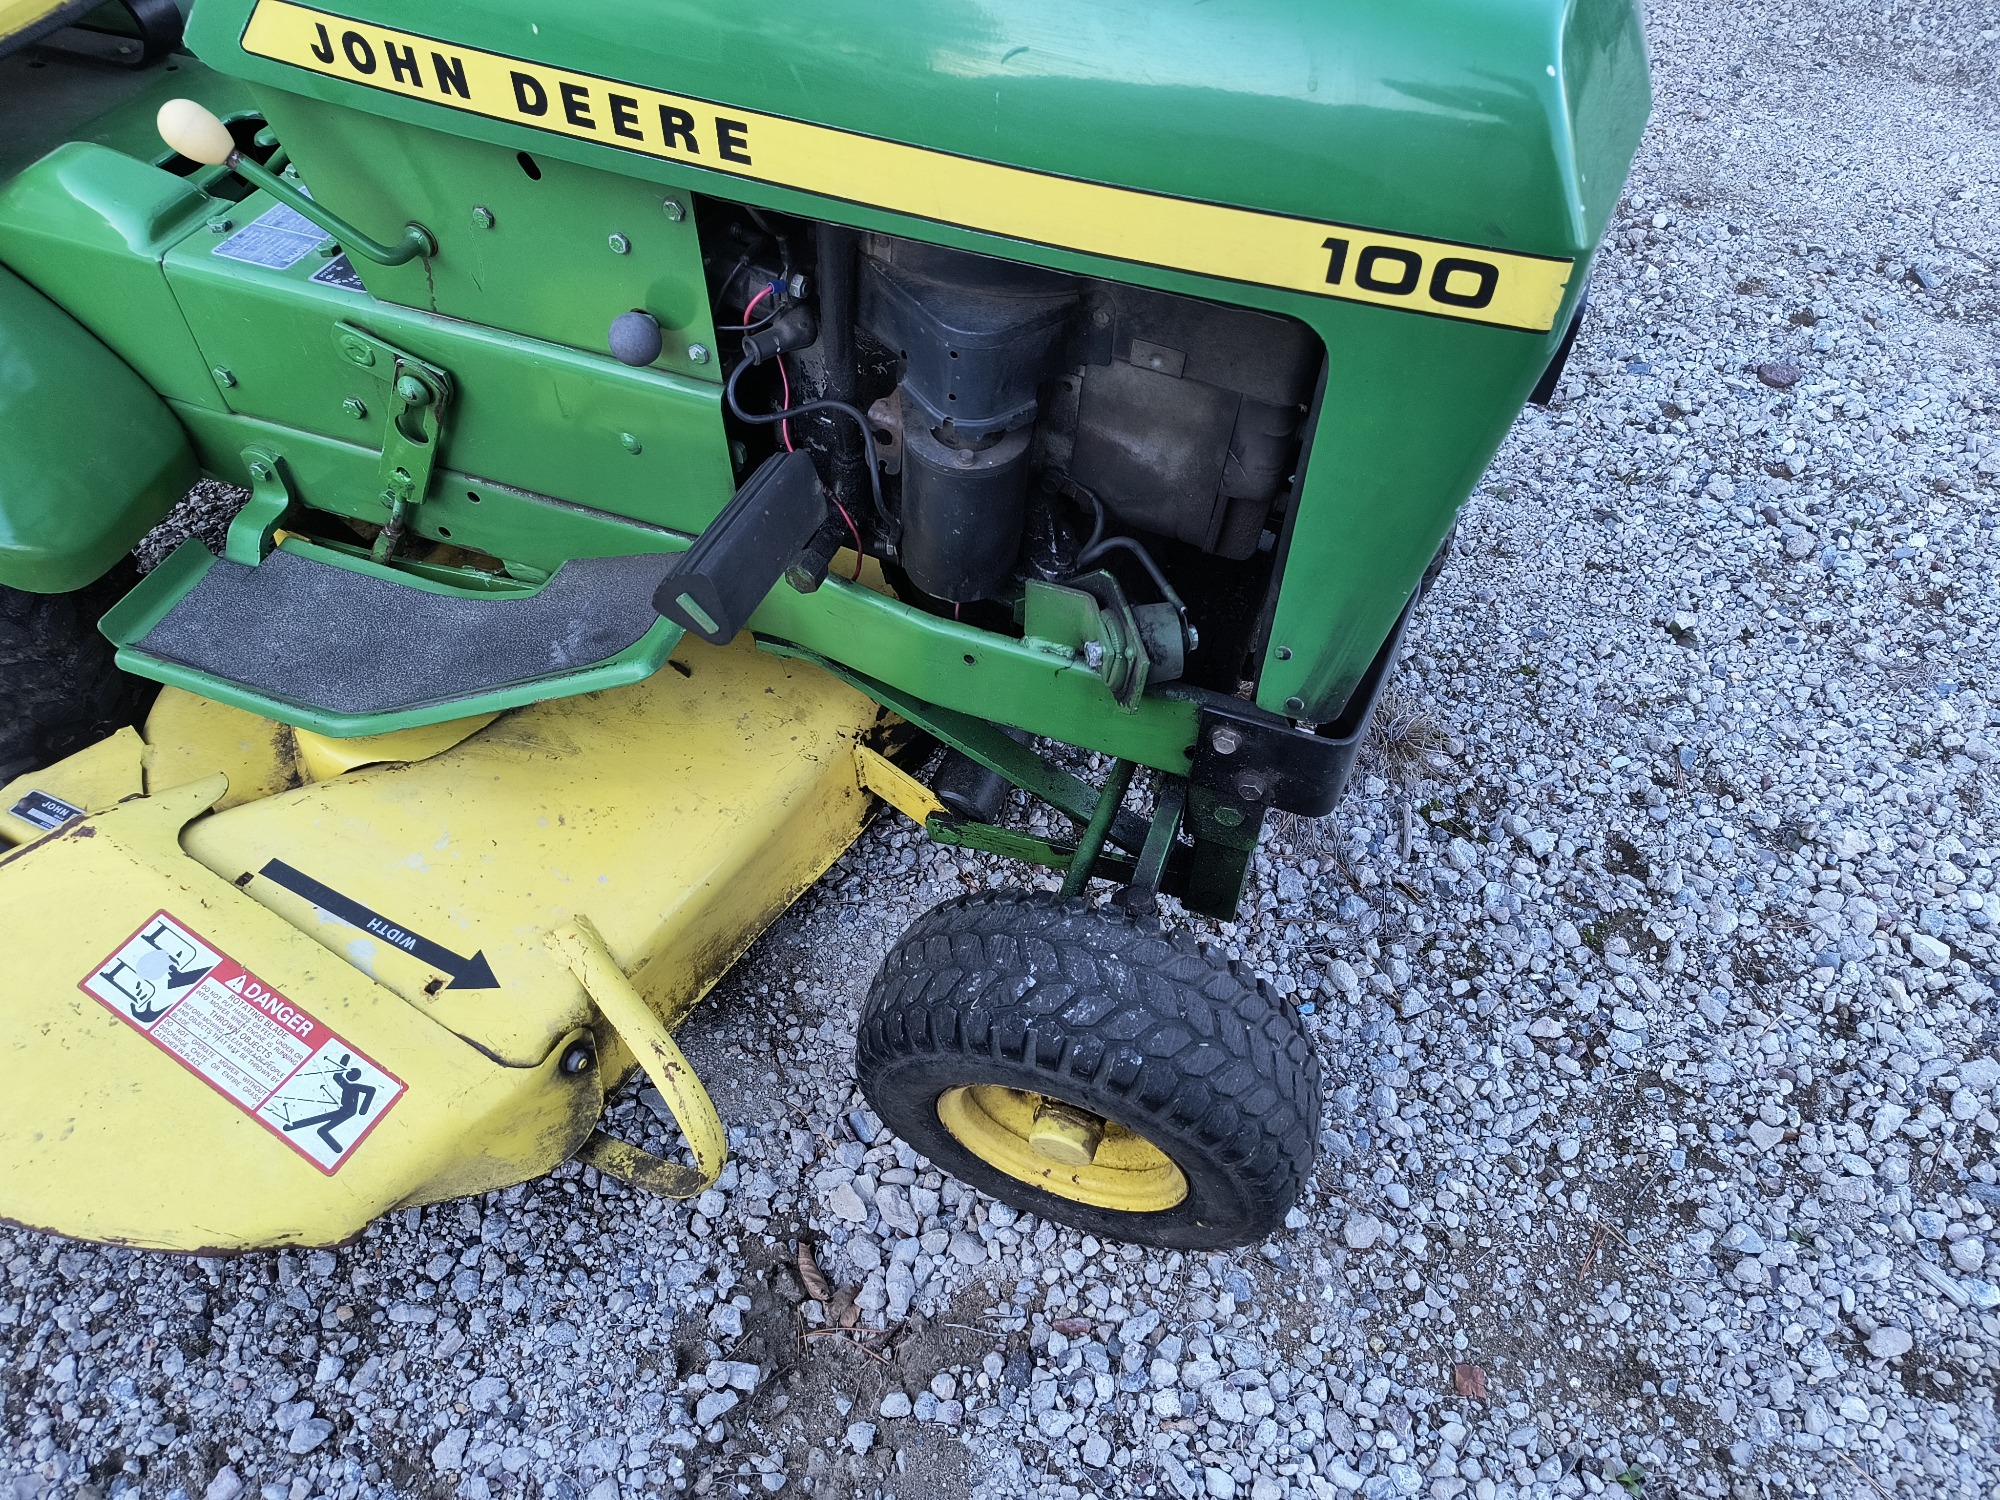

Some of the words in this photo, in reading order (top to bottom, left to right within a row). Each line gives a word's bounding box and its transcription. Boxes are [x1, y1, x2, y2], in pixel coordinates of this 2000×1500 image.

[310, 23, 471, 99] JOHN
[510, 70, 752, 166] DEERE
[1321, 237, 1499, 309] 100
[41, 801, 70, 817] JOHN
[366, 918, 417, 950] WIDTH
[182, 1001, 203, 1018] BEFORE
[224, 1032, 243, 1047] CLEAR
[264, 1061, 286, 1079] PEOPLE
[195, 990, 210, 1001] INTO
[209, 1000, 230, 1016] MOWER
[230, 1015, 247, 1028] WHEN
[246, 1027, 267, 1042] ENGINE
[201, 984, 211, 993] DO
[209, 990, 222, 1001] NOT
[221, 999, 234, 1009] PUT
[232, 1007, 252, 1023] HANDS
[252, 1021, 262, 1030] OR
[260, 1028, 276, 1040] FEET
[275, 1039, 295, 1054] UNDER
[294, 1052, 304, 1060] OR
[209, 1010, 241, 1035] THROWN
[239, 1032, 273, 1059] OBJECTS
[228, 994, 265, 1022] ROTATING
[264, 1020, 289, 1040] BLADE
[243, 982, 315, 1037] DANGER
[152, 1029, 179, 1050] CATCHER
[177, 1047, 186, 1055] IN
[183, 1052, 203, 1068] PLACE
[158, 1024, 189, 1048] DISCHARGE
[189, 1047, 210, 1063] CHUTE
[210, 1062, 221, 1071] OR
[221, 1070, 242, 1087] ENTIRE
[242, 1085, 263, 1102] GRASS
[163, 1019, 174, 1028] DO
[176, 1028, 189, 1039] NOT
[191, 1039, 216, 1059] OPERATE
[218, 1059, 240, 1076] MOWER
[242, 1076, 268, 1096] WITHOUT
[176, 1007, 190, 1018] AND
[188, 1015, 213, 1035] OBJECTS
[212, 1033, 228, 1046] THAT
[239, 1052, 248, 1061] BE
[247, 1059, 272, 1078] THROWN
[270, 1075, 281, 1084] BY
